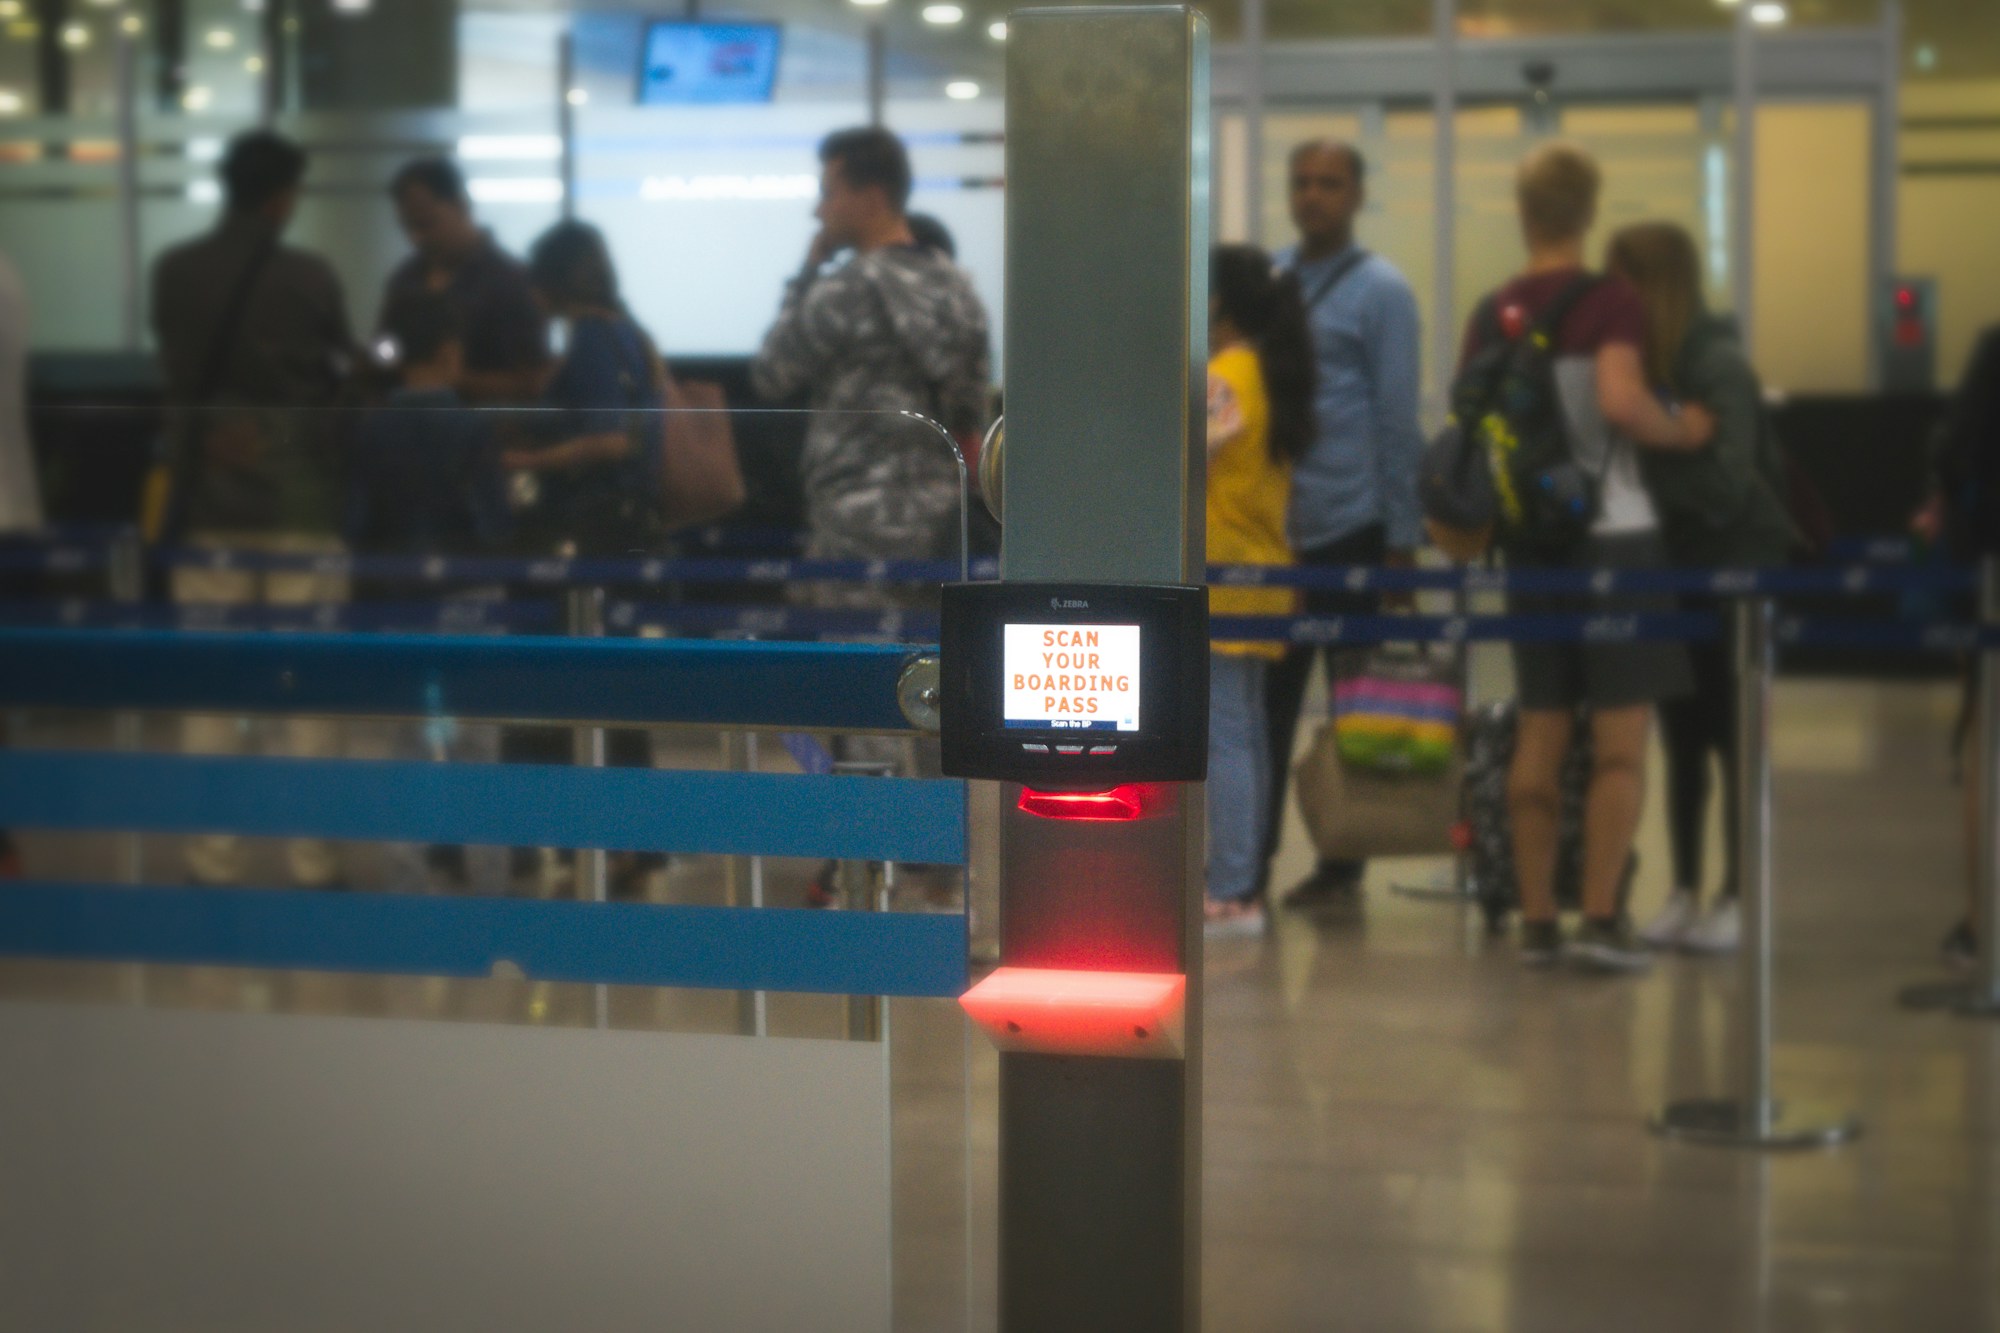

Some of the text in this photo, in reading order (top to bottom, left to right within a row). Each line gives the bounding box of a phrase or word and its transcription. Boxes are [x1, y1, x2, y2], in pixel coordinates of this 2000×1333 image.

[1063, 599, 1089, 608] ZEBRA
[1043, 630, 1099, 647] SCAN
[1042, 652, 1101, 669] YOUR
[1013, 674, 1130, 692] BOARDING
[1044, 696, 1099, 713] PASS
[1050, 719, 1092, 728] Scan the BP
